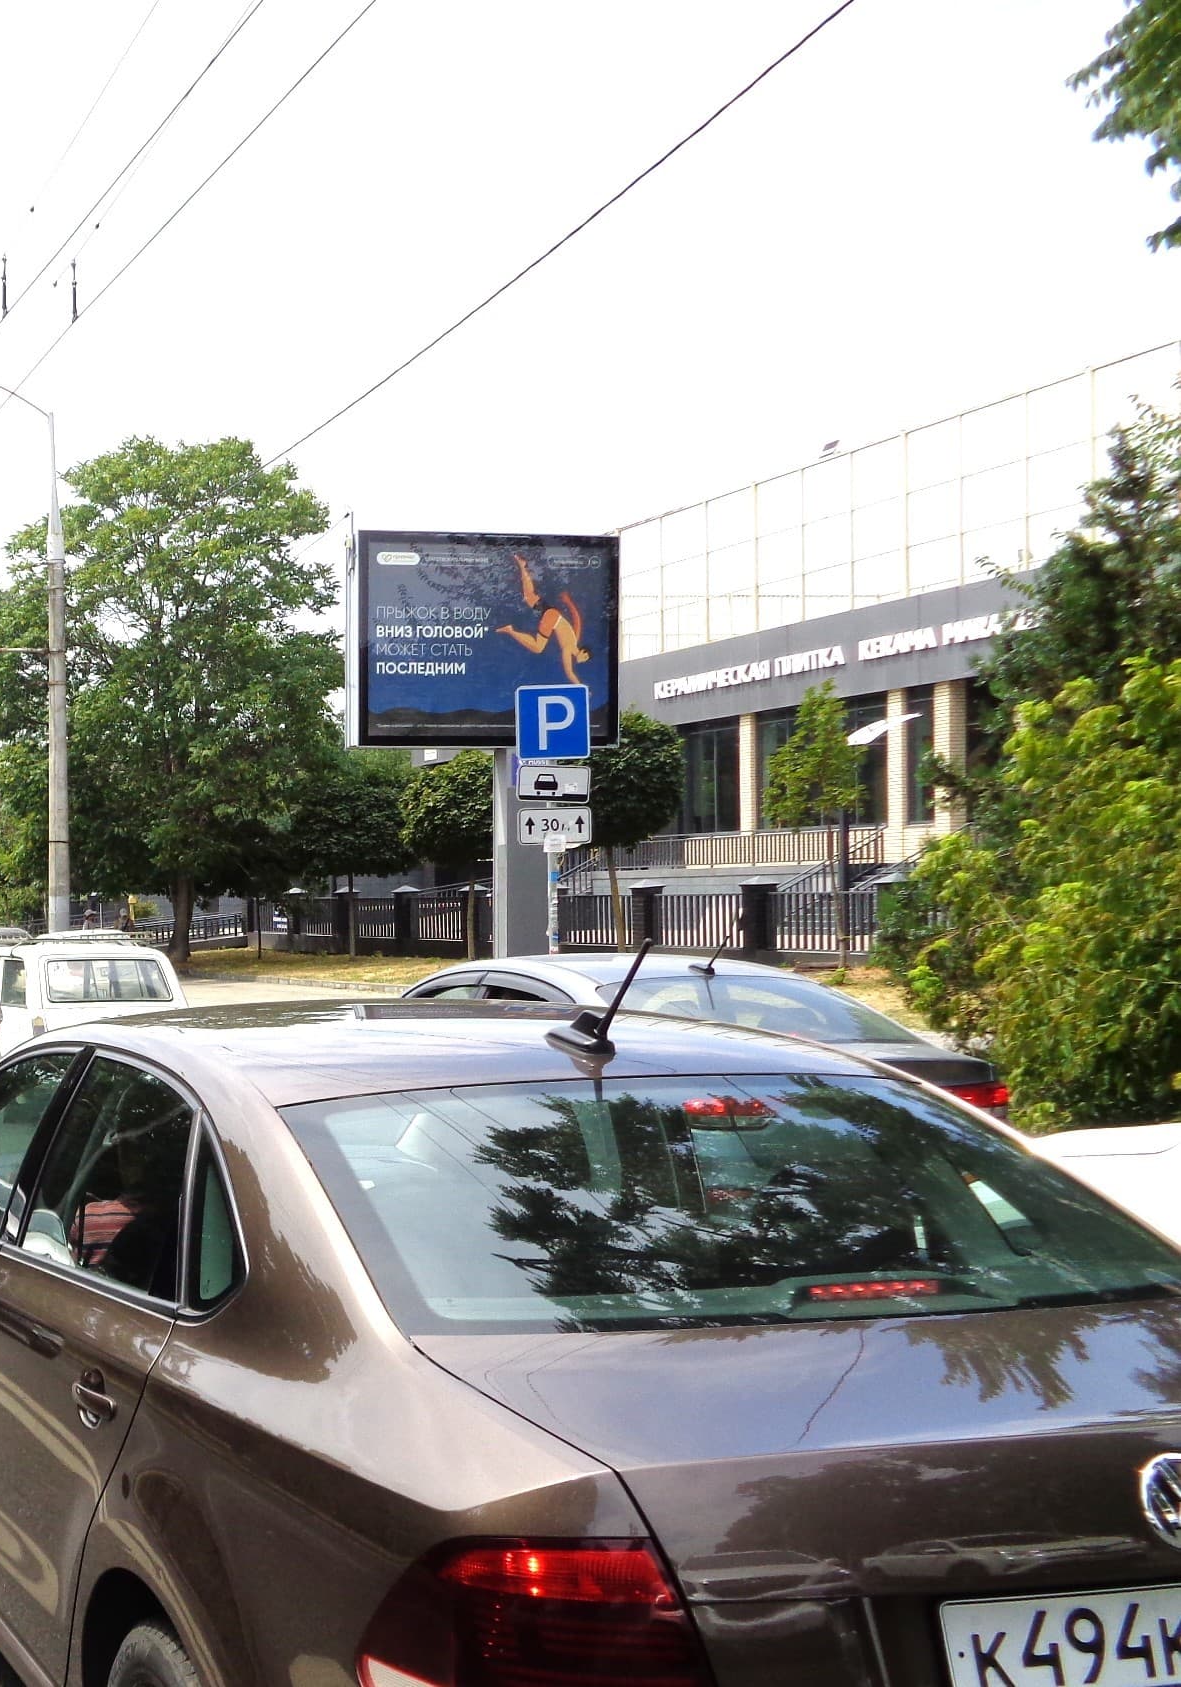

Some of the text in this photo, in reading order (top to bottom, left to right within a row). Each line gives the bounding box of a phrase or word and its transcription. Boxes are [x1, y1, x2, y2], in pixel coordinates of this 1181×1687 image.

[376, 606, 492, 621] ПРЫЖОК В ВОДУ
[376, 625, 413, 638] ВНИЗ
[376, 643, 473, 656] МОЖЕТ СТАТЬ
[376, 661, 466, 676] ПОСЛЕДНИМ
[654, 646, 846, 700] КЕРАМИЧЕСКАЯ ПЛИТКА
[538, 695, 575, 751] P
